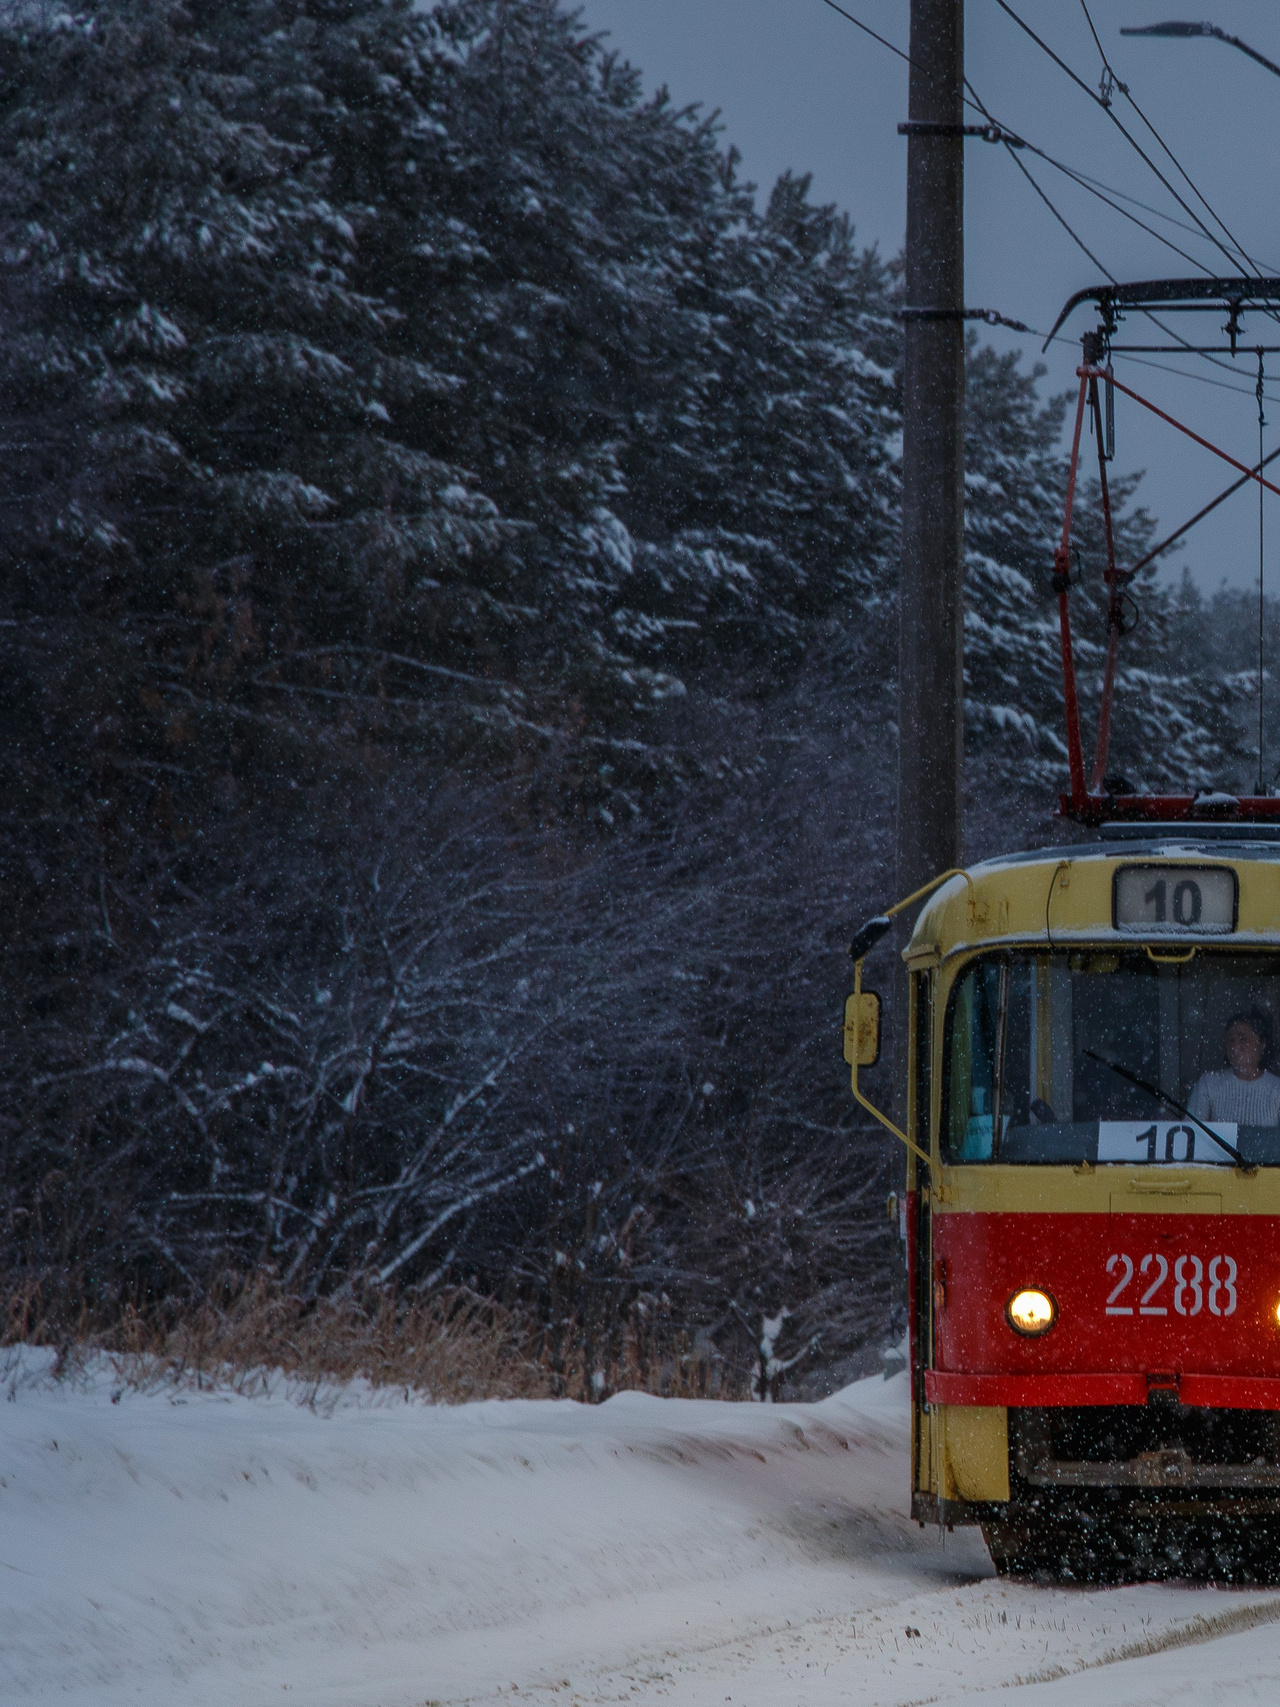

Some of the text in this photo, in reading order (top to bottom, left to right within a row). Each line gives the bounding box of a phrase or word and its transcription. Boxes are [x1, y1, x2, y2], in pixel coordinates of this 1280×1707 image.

[1144, 879, 1203, 925] 10
[1135, 1124, 1196, 1161] 10
[1105, 1253, 1237, 1317] 2288
